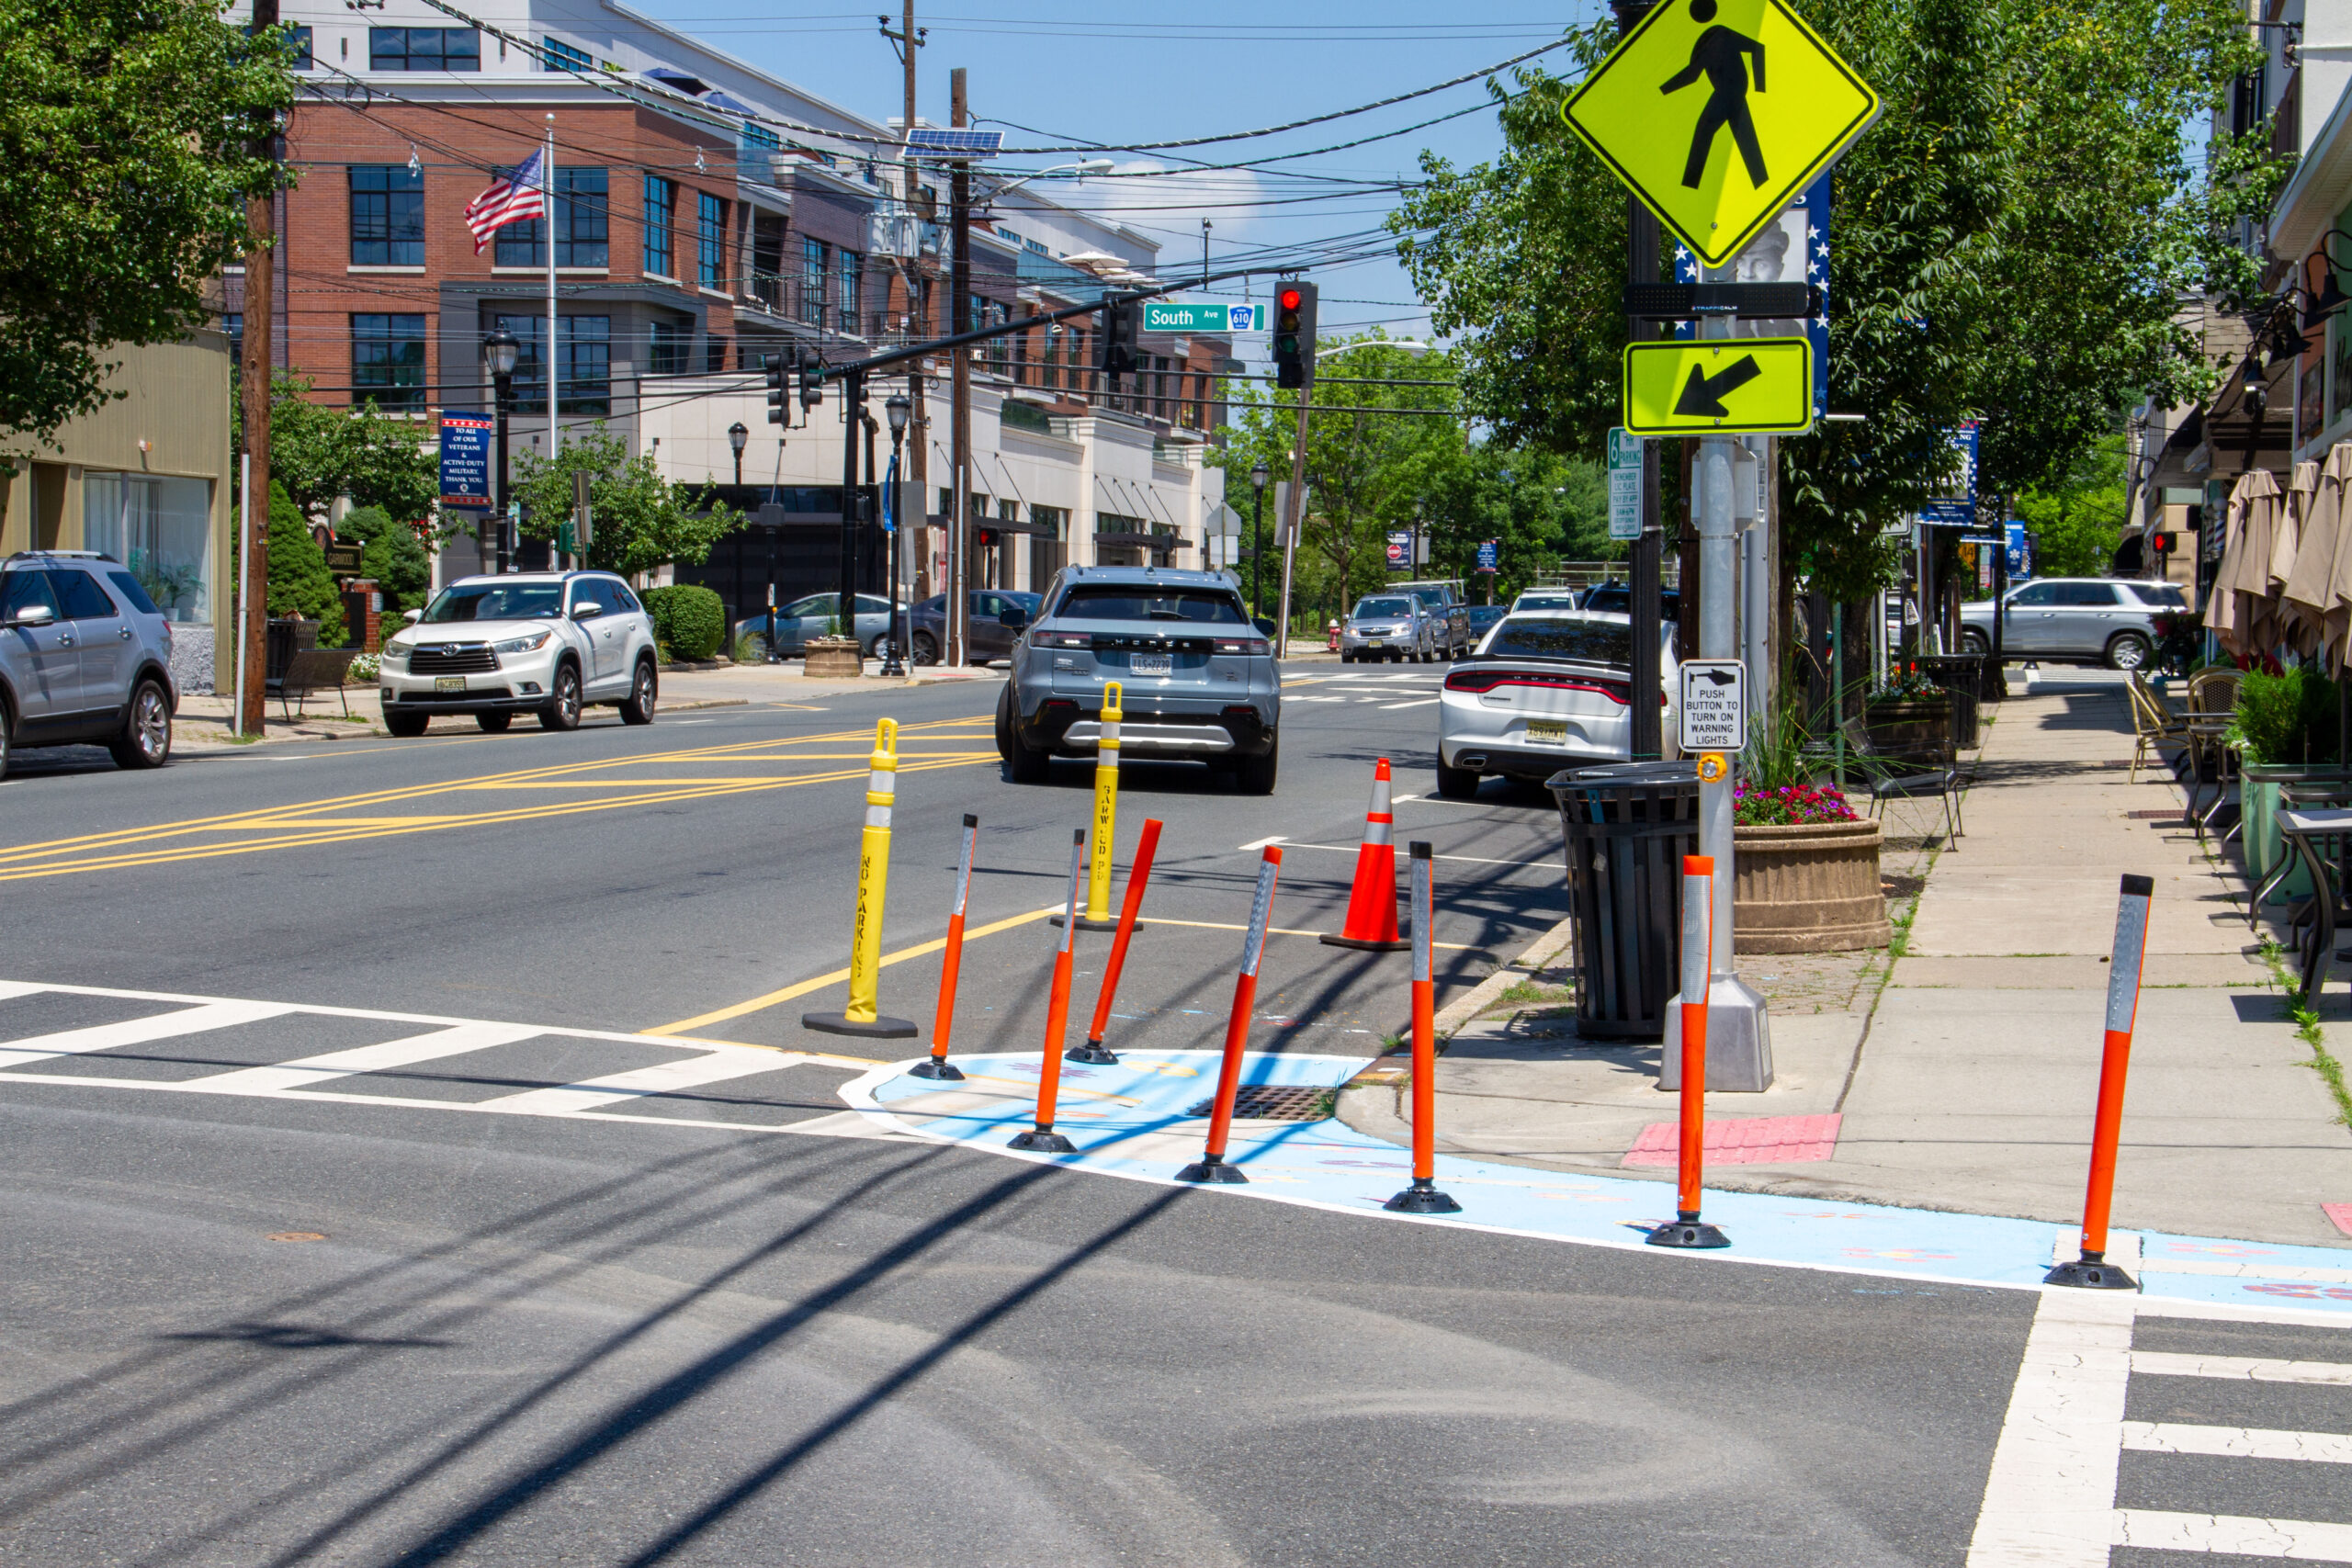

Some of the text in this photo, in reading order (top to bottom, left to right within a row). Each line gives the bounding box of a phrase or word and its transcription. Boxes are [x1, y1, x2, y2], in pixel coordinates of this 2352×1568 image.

[1150, 310, 1218, 325] South Ave
[1232, 312, 1250, 323] 610
[1611, 435, 1619, 462] 6
[1619, 449, 1641, 464] PARKING
[327, 553, 355, 566] GARWOOD
[1699, 689, 1725, 698] PUSH
[1686, 701, 1738, 710] BUTTON TO
[1691, 713, 1734, 721] TURN ON
[1690, 724, 1734, 733] WARNING
[1696, 736, 1728, 744] LIGHTS
[861, 855, 871, 880] NO
